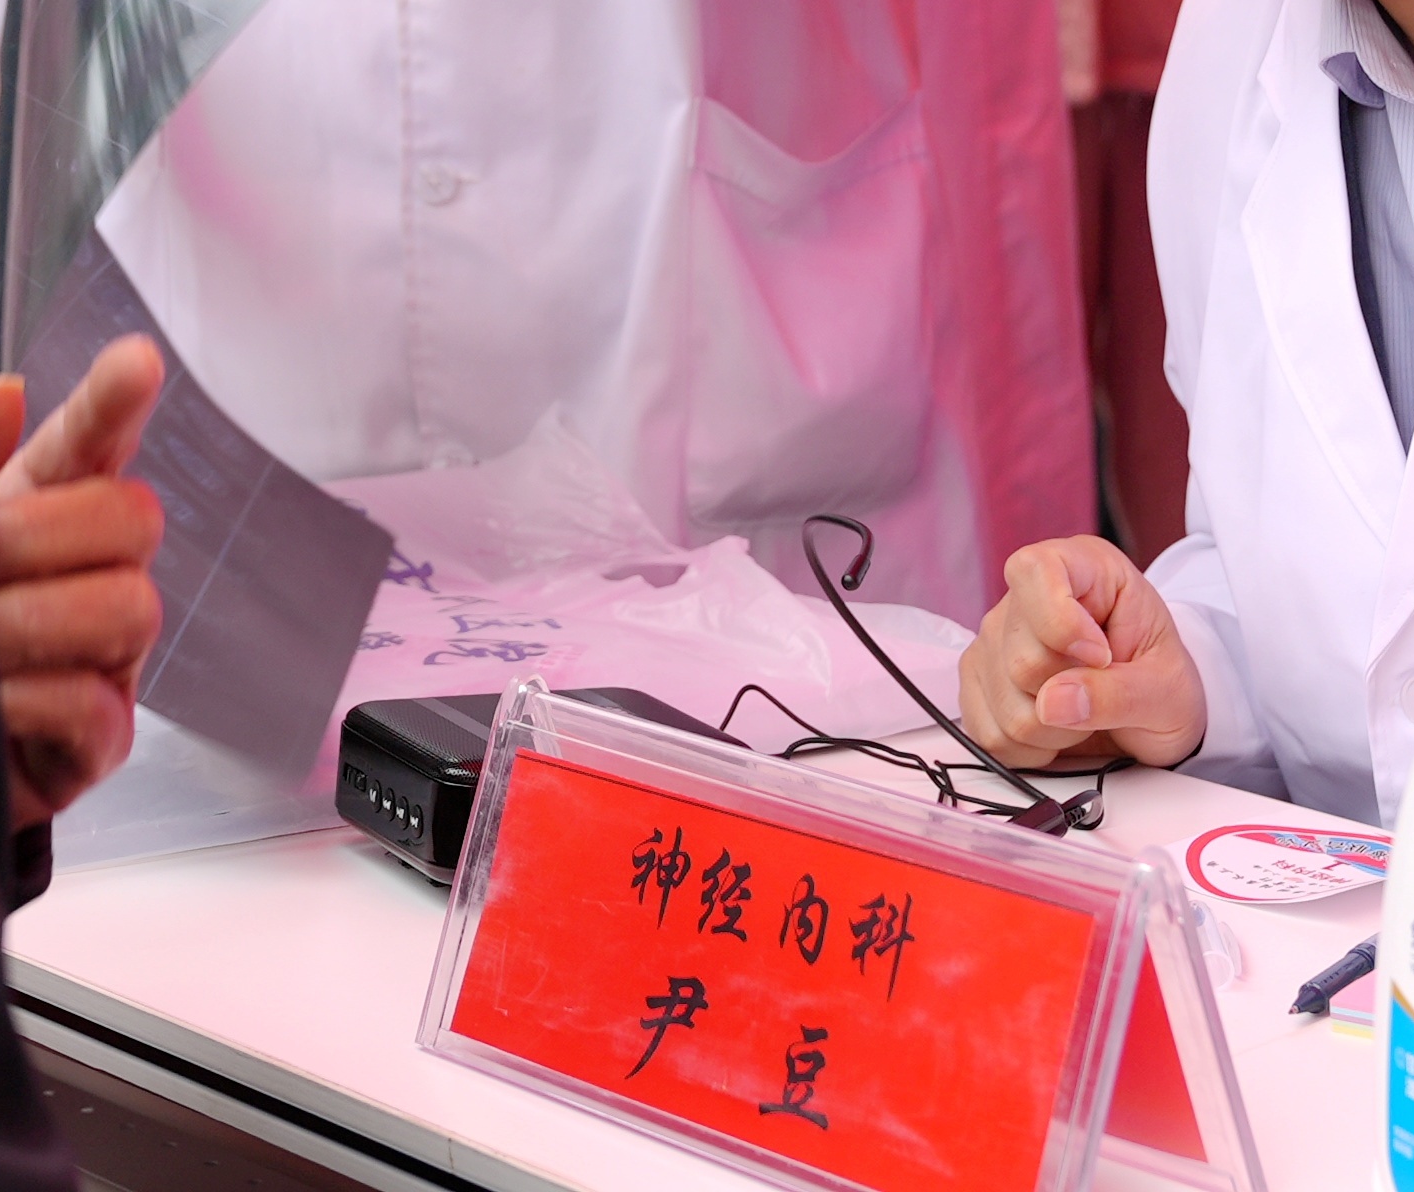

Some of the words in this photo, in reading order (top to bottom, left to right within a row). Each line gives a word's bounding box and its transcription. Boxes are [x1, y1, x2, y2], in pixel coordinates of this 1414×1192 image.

[630, 826, 915, 1002] 神经内科
[625, 975, 831, 1130] 尹豆
